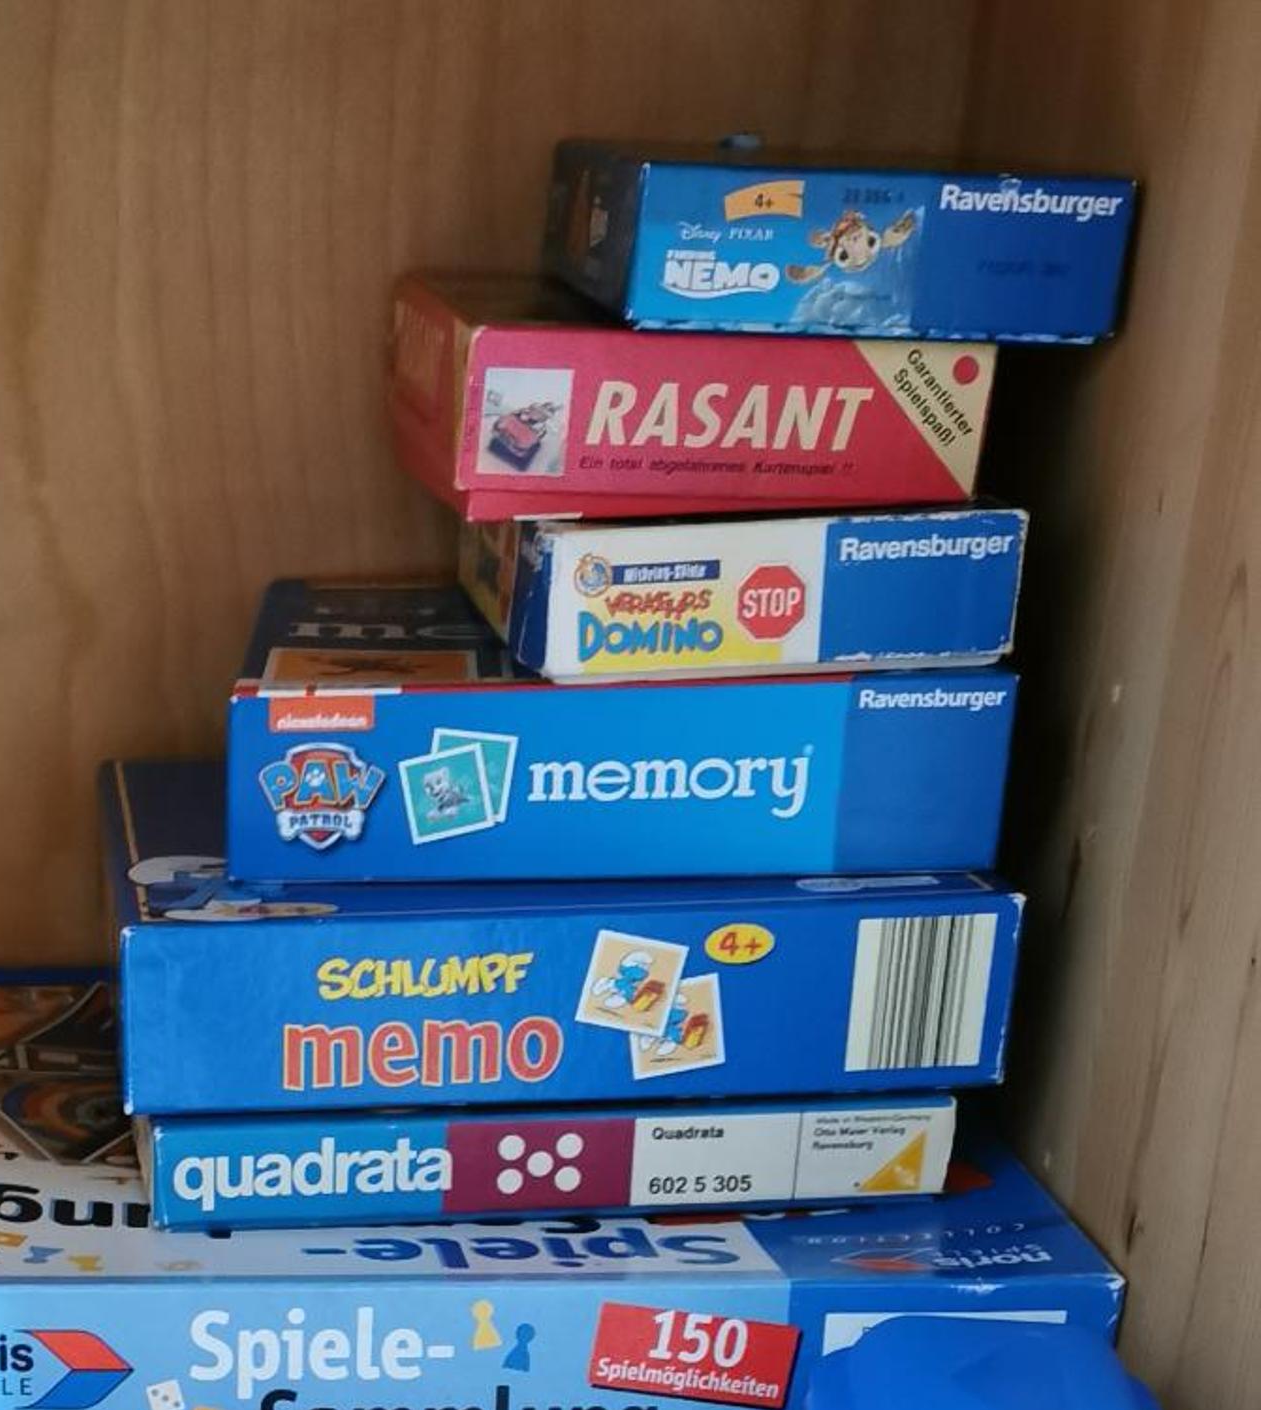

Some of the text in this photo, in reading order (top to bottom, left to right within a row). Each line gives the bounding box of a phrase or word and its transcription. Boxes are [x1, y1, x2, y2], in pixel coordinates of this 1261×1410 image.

[940, 183, 1123, 222] Ravensburger
[663, 260, 781, 293] NEMO
[893, 367, 957, 447] Spielspaß!
[907, 348, 974, 436] Garantierter
[585, 380, 876, 454] RASANT
[839, 533, 1014, 563] Ravensburger
[740, 583, 802, 621] STOP
[577, 610, 724, 663] DOMINO
[858, 687, 1007, 711] Ravensburger
[258, 758, 387, 811] PAW
[528, 753, 811, 820] memory
[287, 813, 353, 830] PATROL
[716, 931, 764, 958] 4+
[316, 950, 535, 1000] SCHLUMPF
[281, 1014, 565, 1091] memo
[651, 1124, 725, 1141] Quadrata
[172, 1136, 453, 1212] quadrata
[648, 1174, 753, 1195] 602 5 305
[301, 1227, 741, 1269] Spiele-
[188, 1306, 456, 1400] Spiele-
[648, 1309, 749, 1368] 150
[596, 1356, 780, 1400] Spielmöglichkeiten
